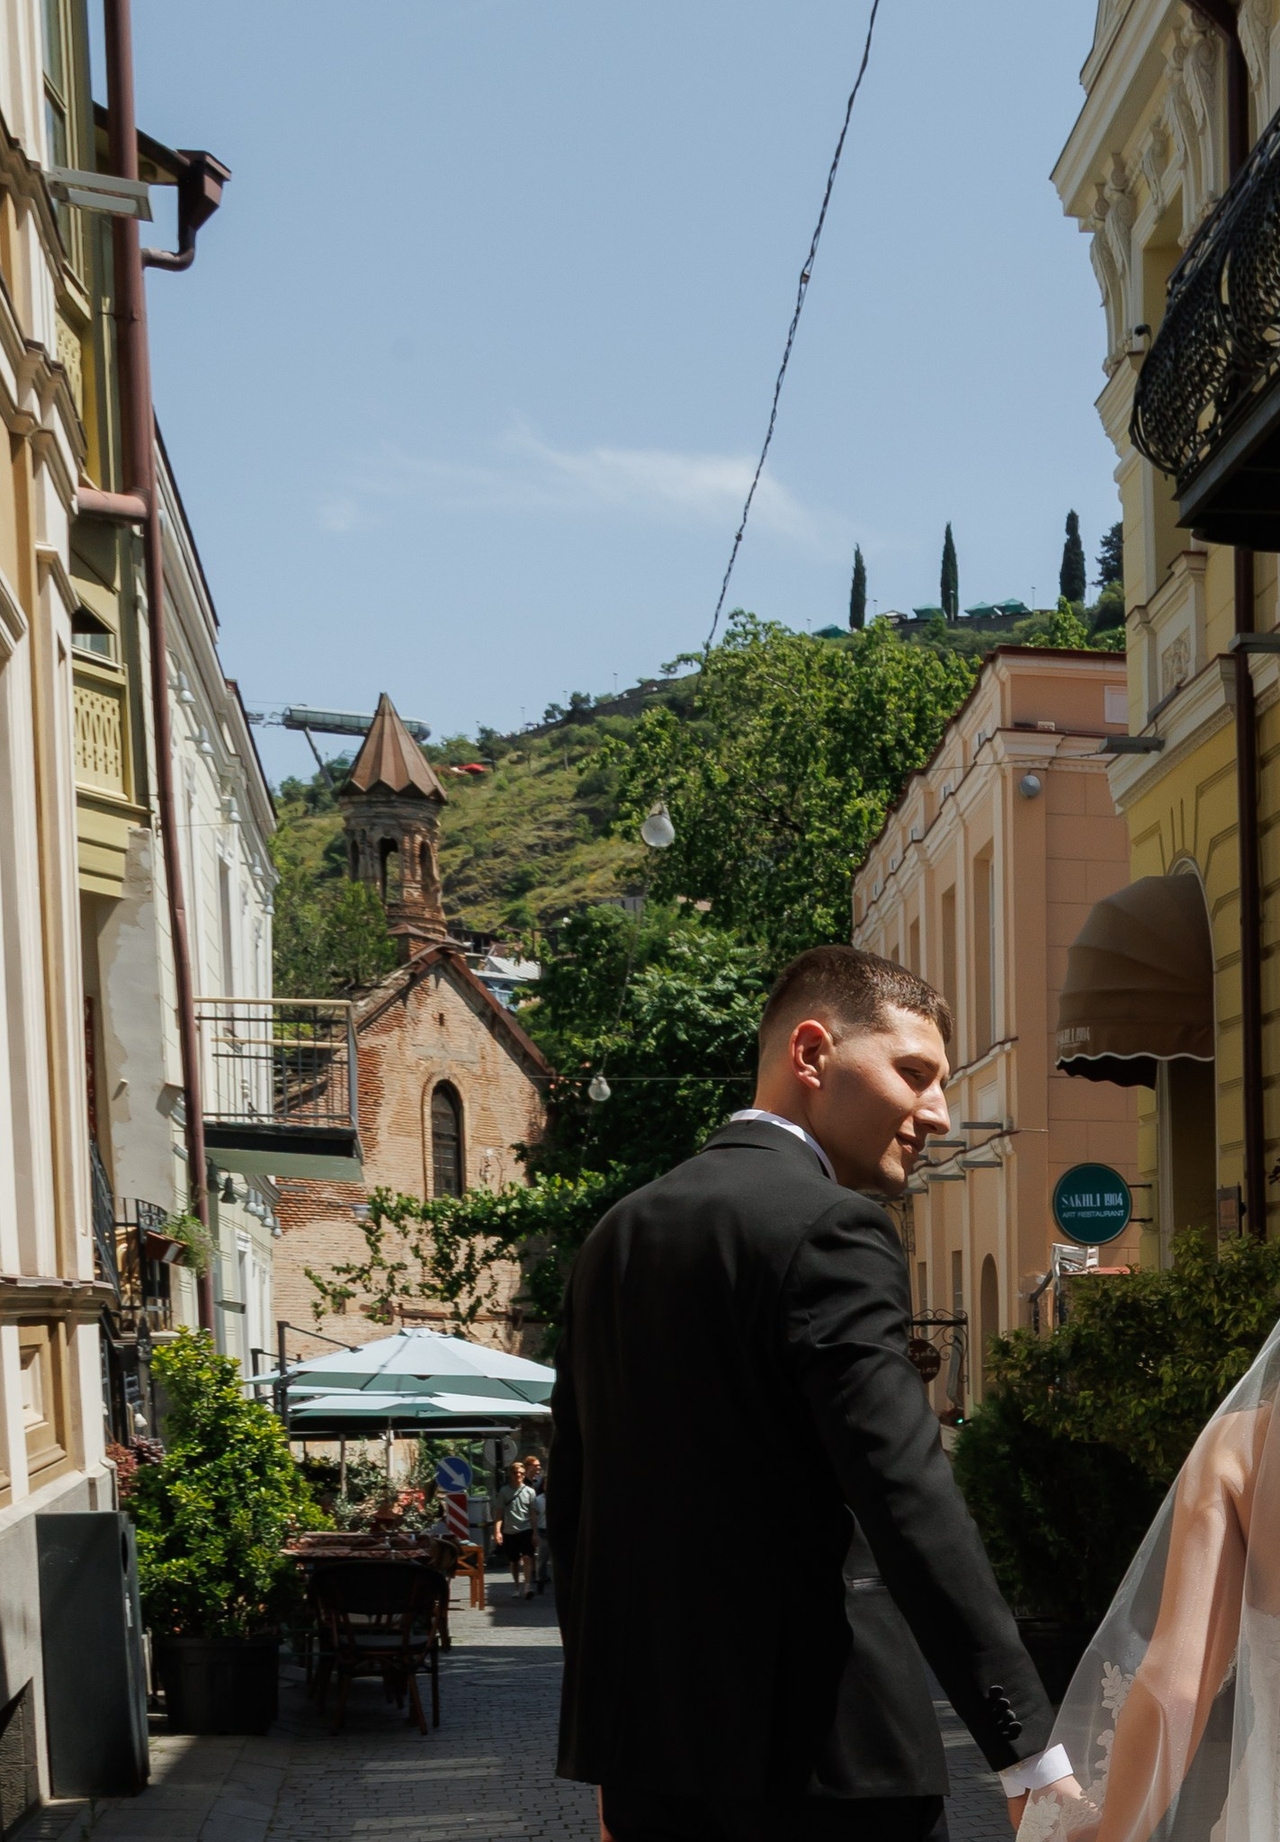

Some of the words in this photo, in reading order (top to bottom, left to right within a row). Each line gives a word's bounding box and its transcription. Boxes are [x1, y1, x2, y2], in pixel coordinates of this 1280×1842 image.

[1062, 1193, 1100, 1208] SAKHLI
[1104, 1192, 1123, 1206] 1904
[1077, 1210, 1125, 1218] RESTAURANT
